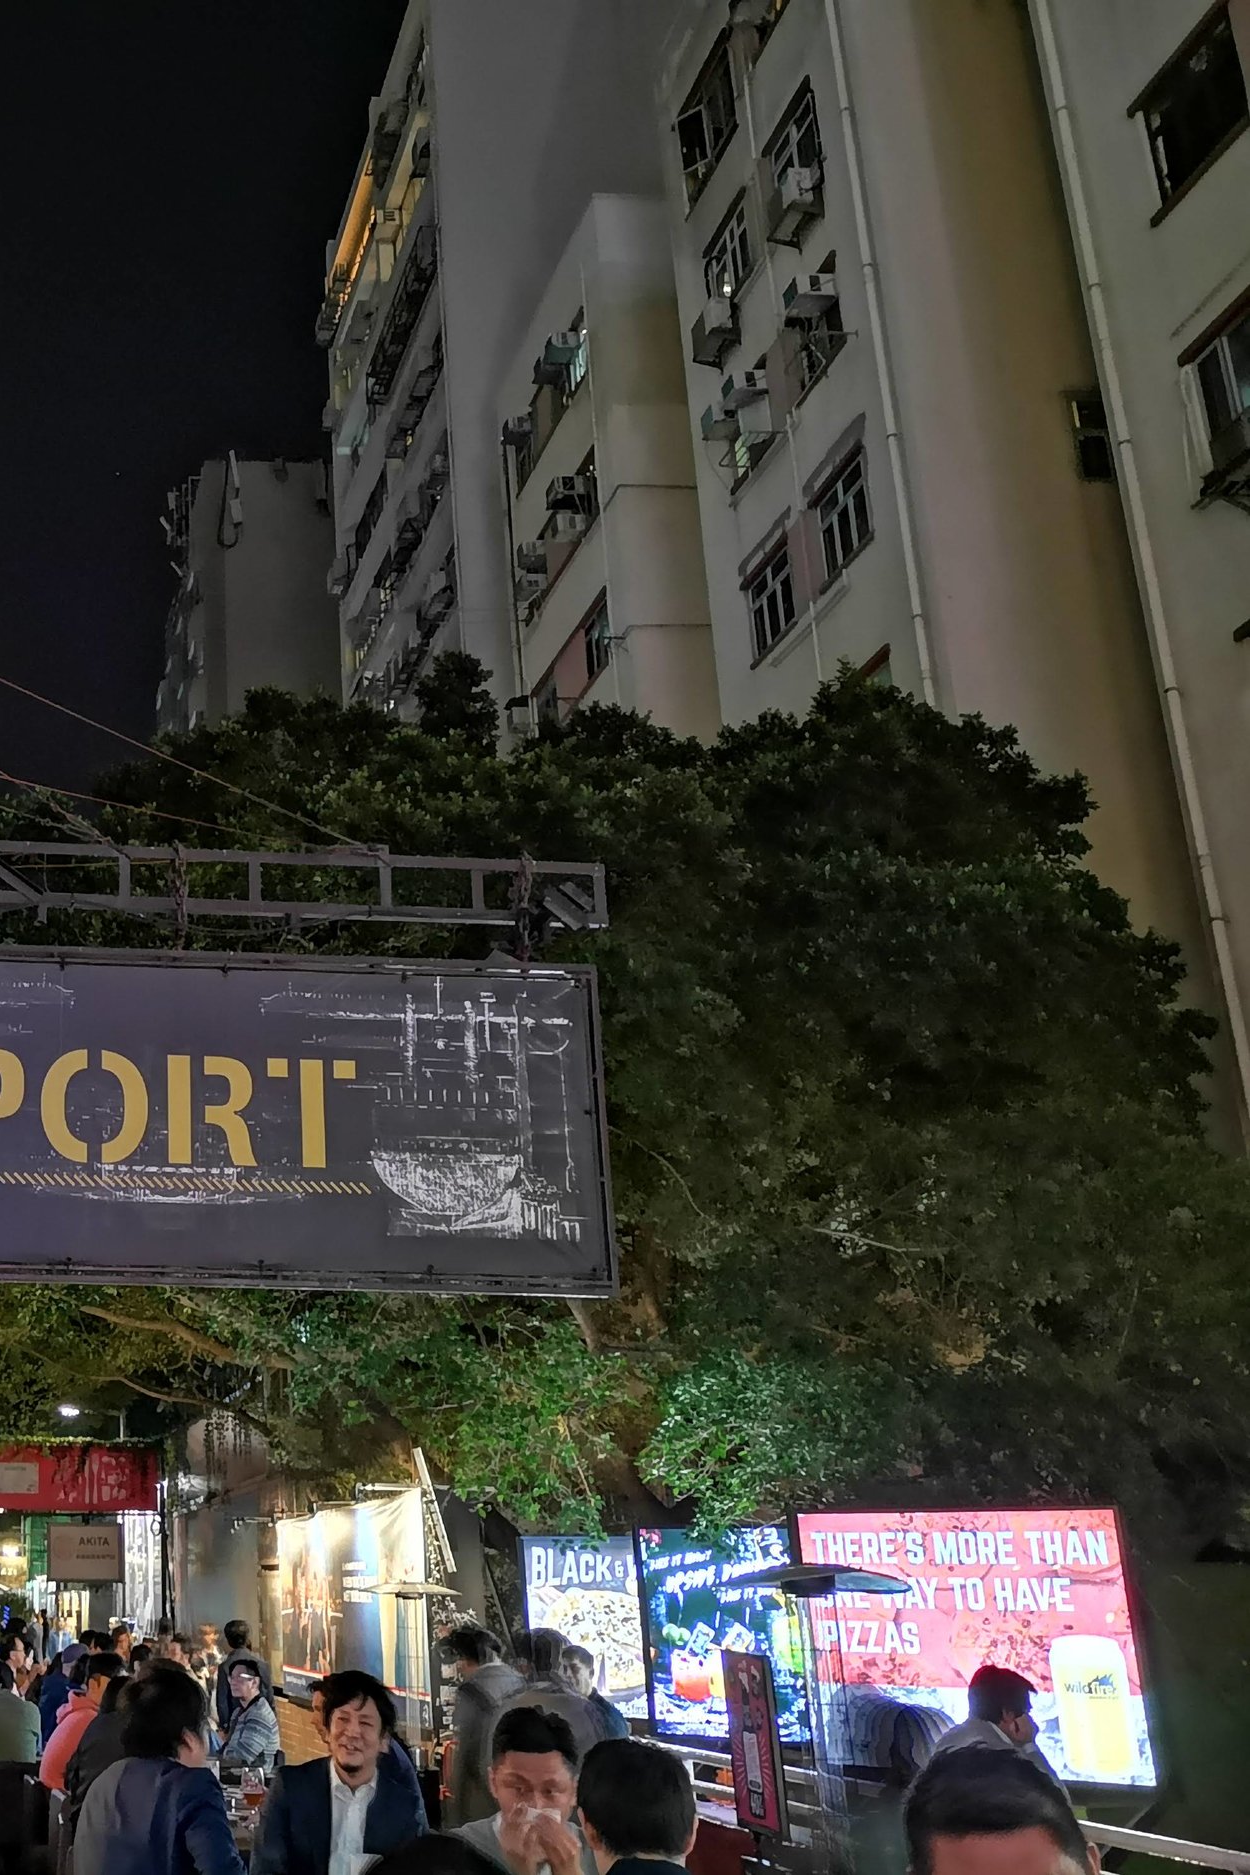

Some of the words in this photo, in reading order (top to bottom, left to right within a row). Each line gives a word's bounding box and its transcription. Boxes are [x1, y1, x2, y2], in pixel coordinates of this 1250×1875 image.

[79, 1537, 110, 1546] AKITA
[810, 1531, 925, 1564] THERE'S
[932, 1530, 1017, 1565] MORE
[1024, 1530, 1110, 1565] THAN
[531, 1546, 612, 1587] BLACK
[614, 1560, 625, 1578] &
[883, 1577, 939, 1610] WAY
[948, 1578, 986, 1611] TO
[994, 1577, 1075, 1612] HAVE
[820, 1619, 921, 1655] PIZZAS
